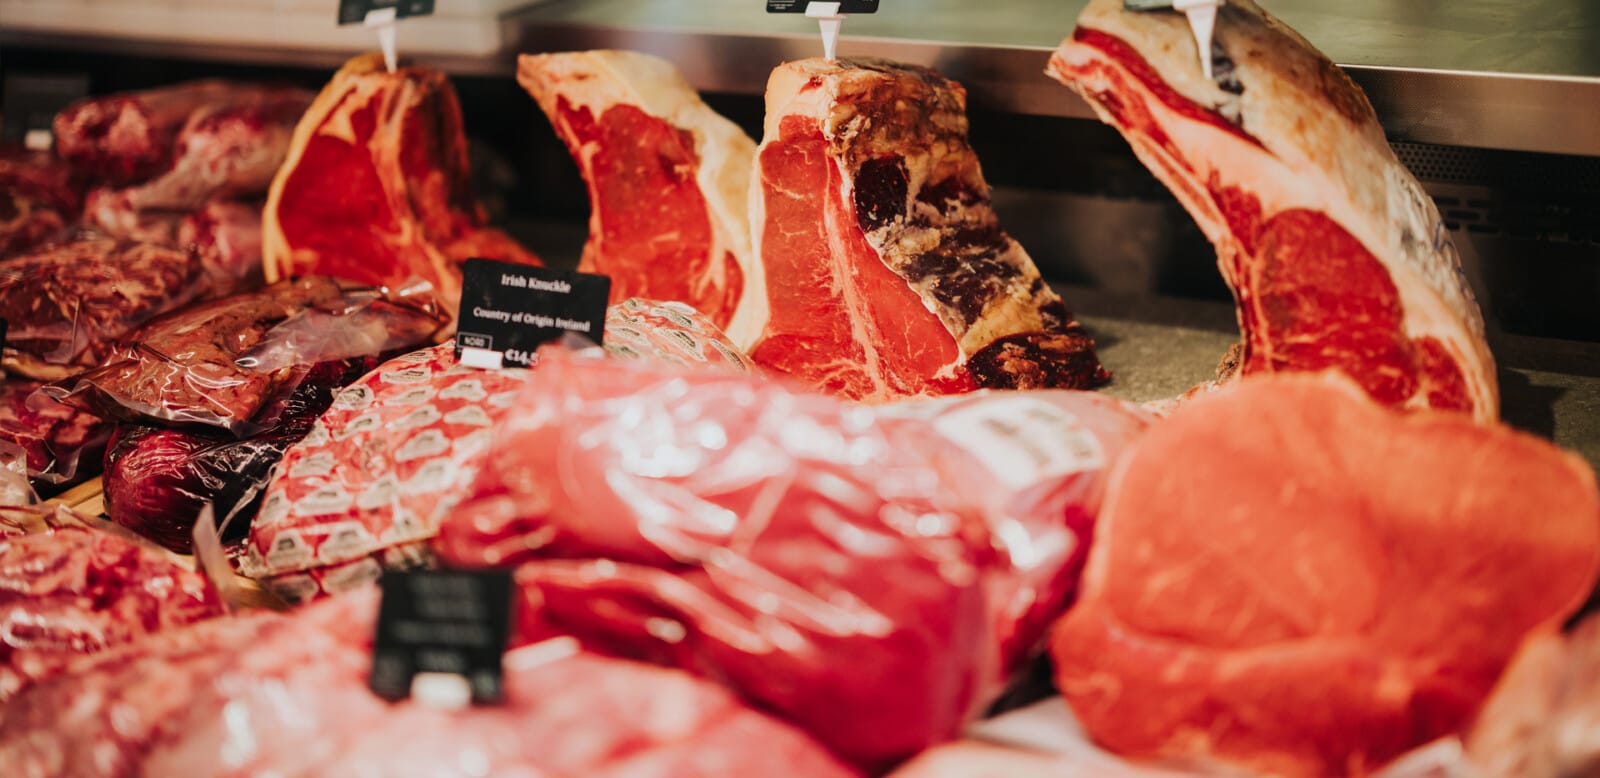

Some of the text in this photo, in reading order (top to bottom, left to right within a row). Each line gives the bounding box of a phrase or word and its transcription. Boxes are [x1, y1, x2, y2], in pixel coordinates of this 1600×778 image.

[501, 274, 572, 294] Irish Knuckle
[473, 306, 591, 332] Country of Origin Ireland
[505, 349, 541, 366] €14.5
